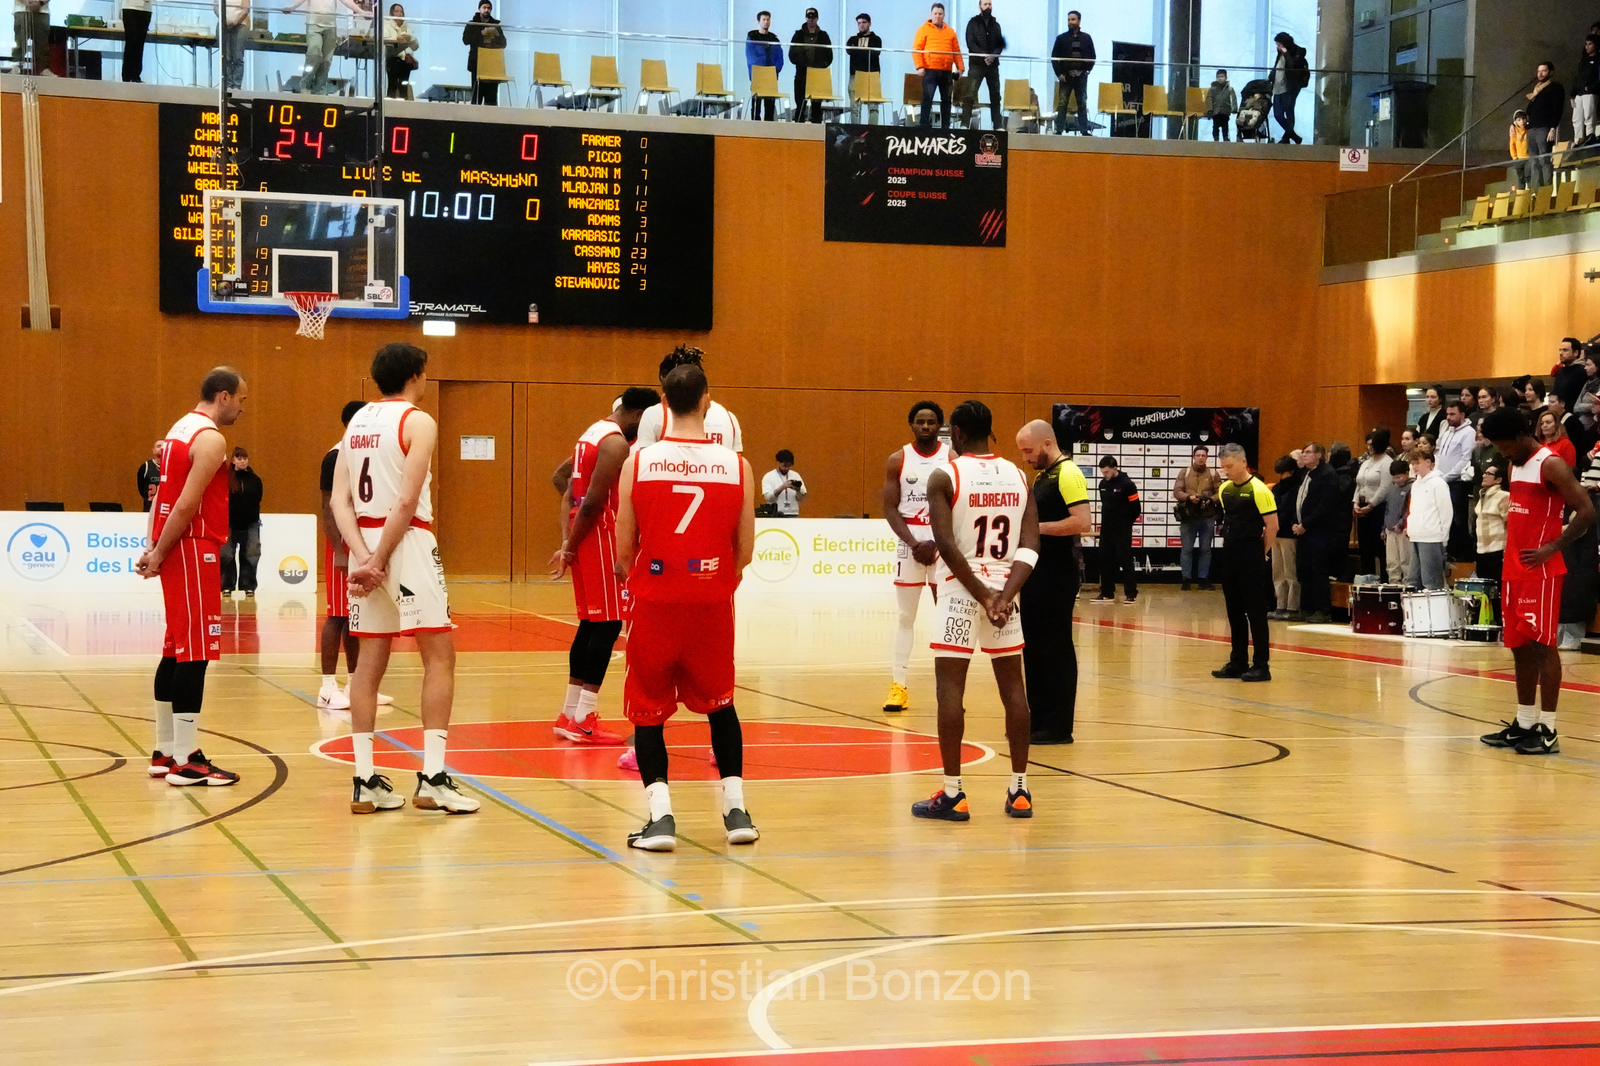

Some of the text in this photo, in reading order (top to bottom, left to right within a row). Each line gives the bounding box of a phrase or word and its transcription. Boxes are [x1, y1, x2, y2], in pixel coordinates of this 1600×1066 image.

[275, 128, 323, 159] 24
[392, 126, 409, 154] 0
[449, 132, 455, 154] 1
[521, 133, 539, 161] 0
[581, 133, 648, 149] FARMER 0
[885, 131, 968, 159] PALMARÈS
[587, 150, 648, 165] PICCO 1
[561, 164, 648, 180] MLADJAN M 7
[887, 167, 965, 178] CHAMPION SUISSE
[561, 180, 648, 196] MLADJAN D 11
[887, 176, 908, 185] 2025
[887, 190, 948, 200] COUPE SUISSE
[409, 189, 496, 221] 10:00
[525, 198, 541, 221] 0
[568, 197, 648, 213] MANZAMBI 12
[887, 199, 907, 208] 2025
[259, 214, 269, 227] 8
[587, 213, 648, 228] ADAMS 3
[561, 228, 648, 244] KARABASIC 17
[255, 247, 269, 260] 19
[574, 244, 648, 260] CASSANO 23
[250, 263, 269, 276] 21
[587, 261, 648, 275] HAYES 24
[251, 280, 269, 293] 33
[554, 275, 648, 291] STEVANOVIC 3
[366, 292, 382, 300] SBL
[409, 301, 487, 313] STRAMATEL
[350, 434, 381, 449] GRAVET
[1121, 431, 1192, 440] GRAND-SACONNEX
[649, 459, 728, 476] mladjan m.
[358, 456, 374, 503] 6
[969, 492, 1020, 508] GILBREATH
[671, 484, 705, 535] 7
[812, 533, 896, 552] Électricité
[974, 514, 1011, 560] 13
[22, 551, 55, 562] eau
[757, 549, 792, 561] vitale
[86, 558, 122, 573] des
[812, 561, 834, 574] de
[837, 564, 857, 574] ce
[949, 596, 978, 608] BOWLING
[945, 626, 970, 636] stop
[943, 633, 969, 646] GYM
